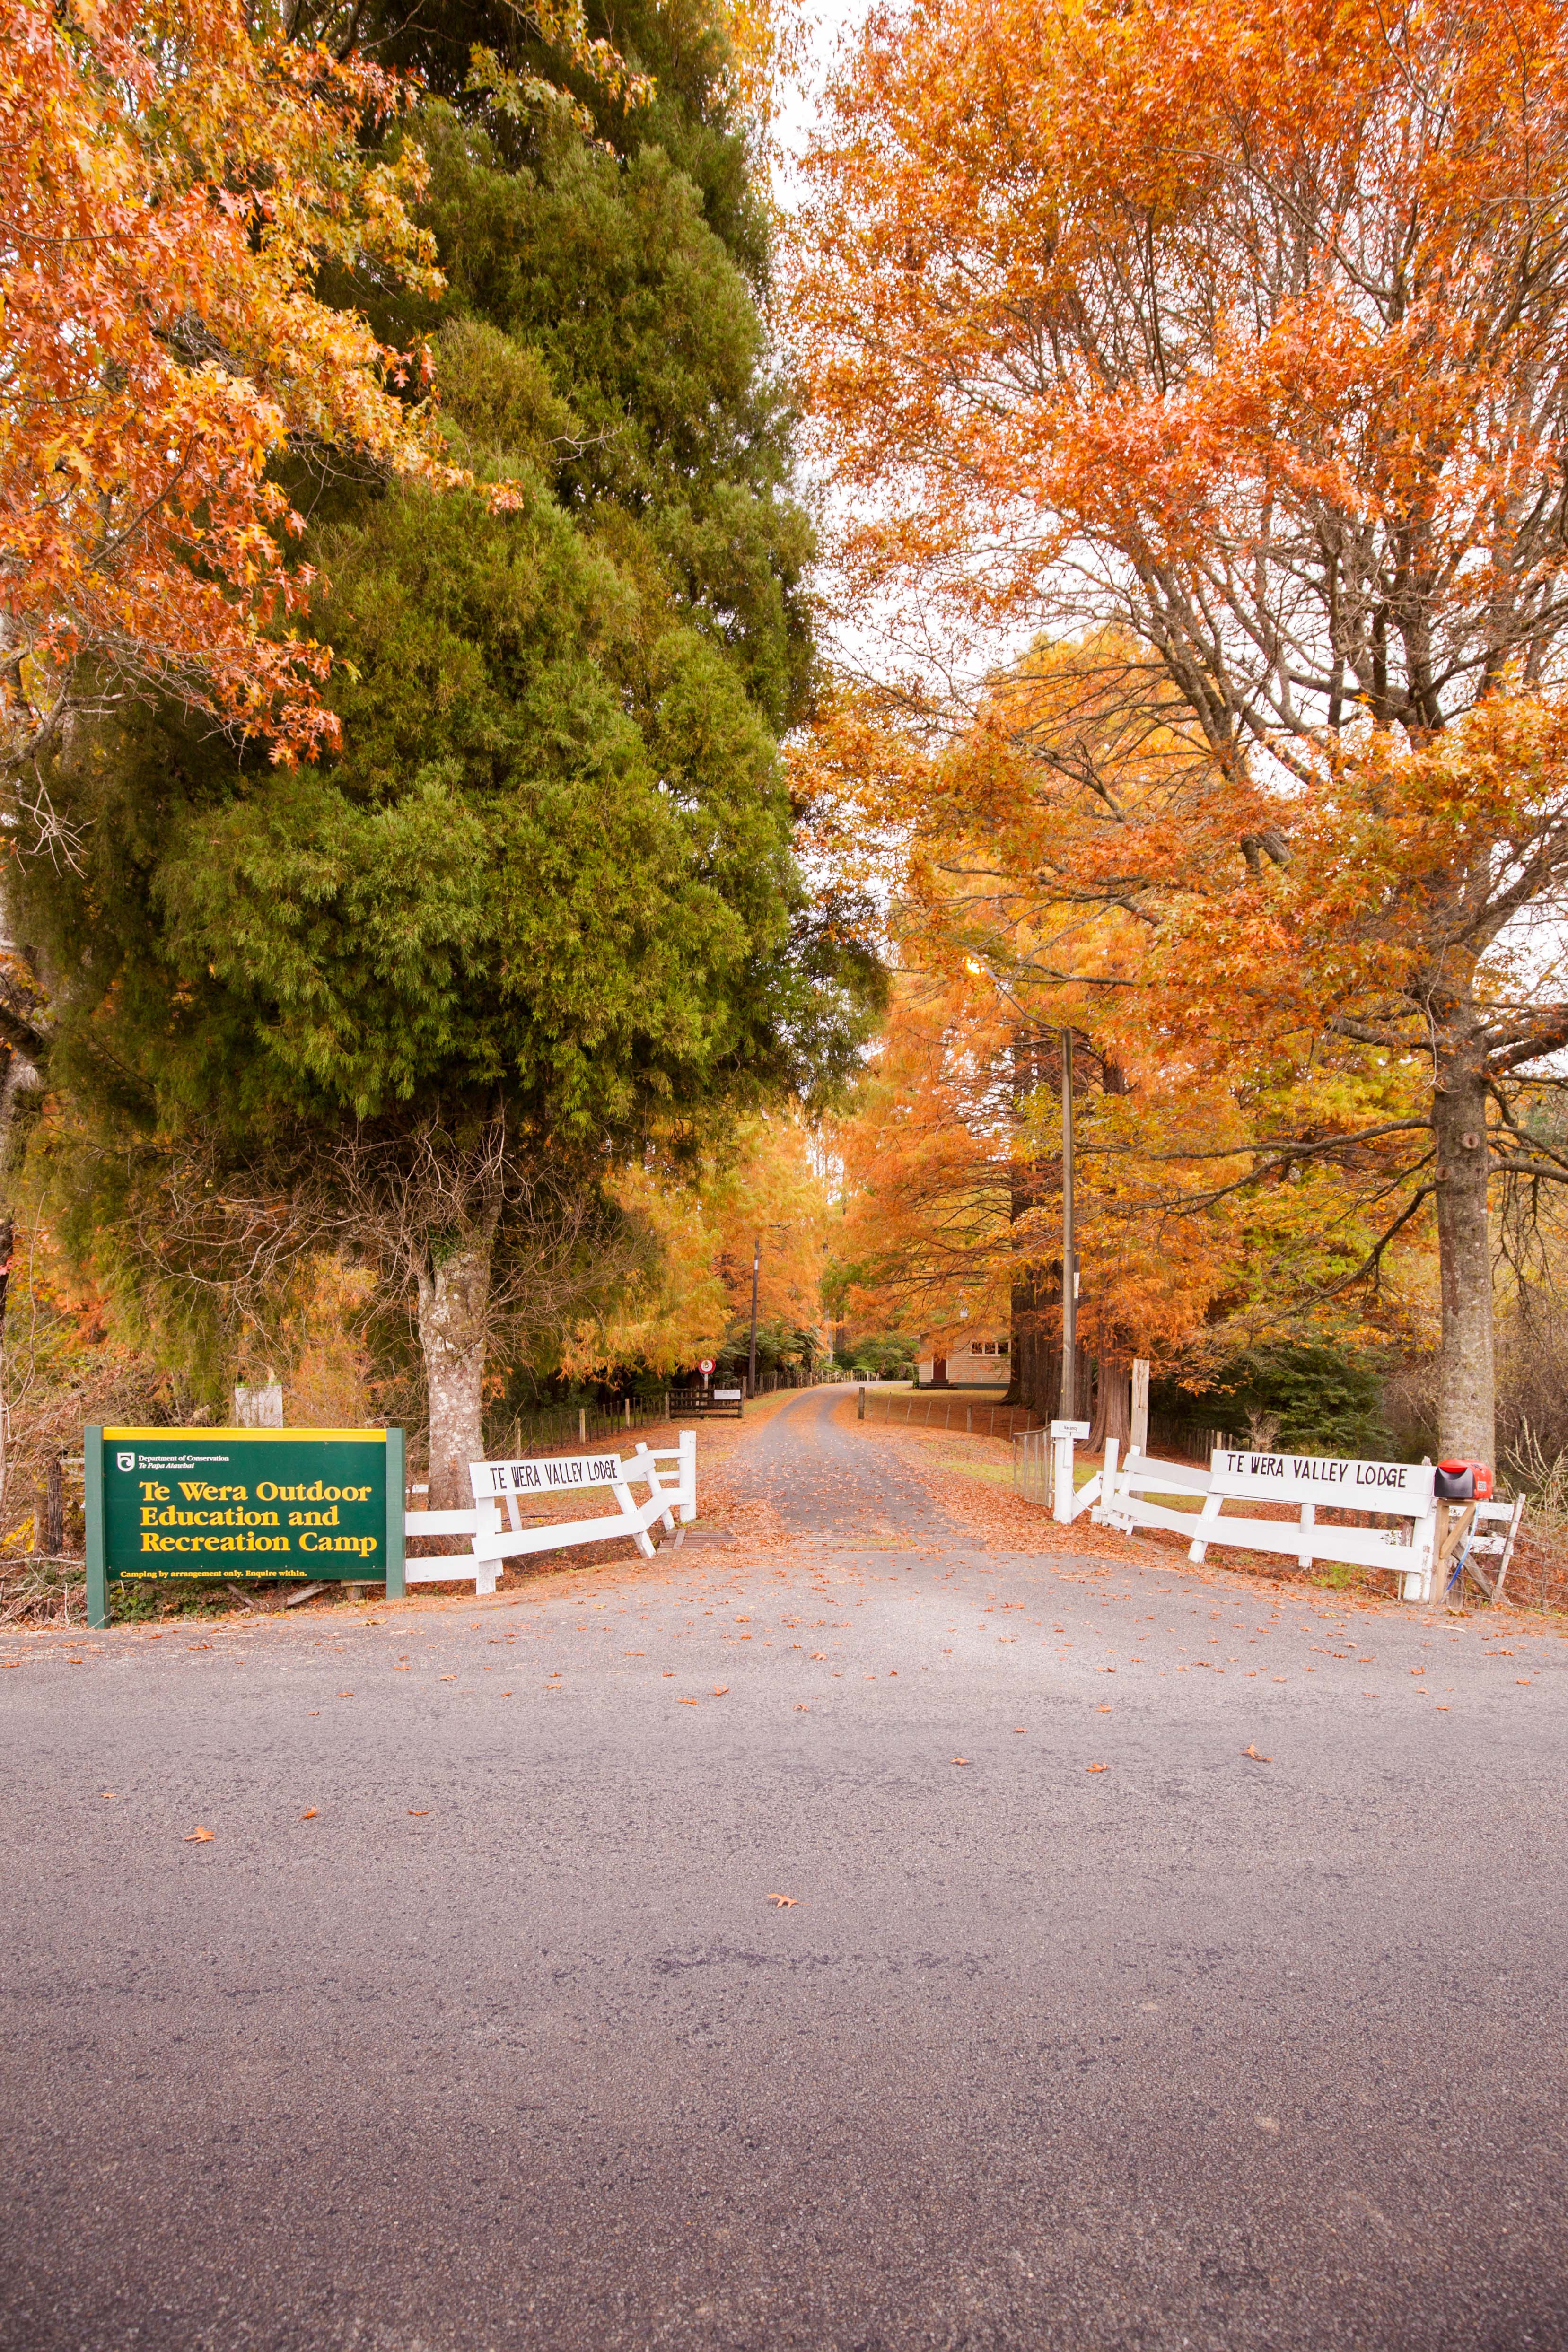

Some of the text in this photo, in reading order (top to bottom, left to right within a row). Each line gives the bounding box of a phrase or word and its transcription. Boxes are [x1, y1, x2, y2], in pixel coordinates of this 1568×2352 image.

[490, 1460, 618, 1490] TE WERA VALLEY LODGE
[1227, 1454, 1408, 1488] TE WERA VALLEY LODGE
[139, 1480, 372, 1501] Te Wera Outdoor
[140, 1505, 340, 1526] Education and
[140, 1531, 377, 1557] Recreation Camp
[120, 1571, 157, 1579] Camping
[158, 1570, 169, 1578] by
[170, 1570, 221, 1578] arrangement
[223, 1570, 244, 1578] only.
[245, 1570, 277, 1578] Enquire
